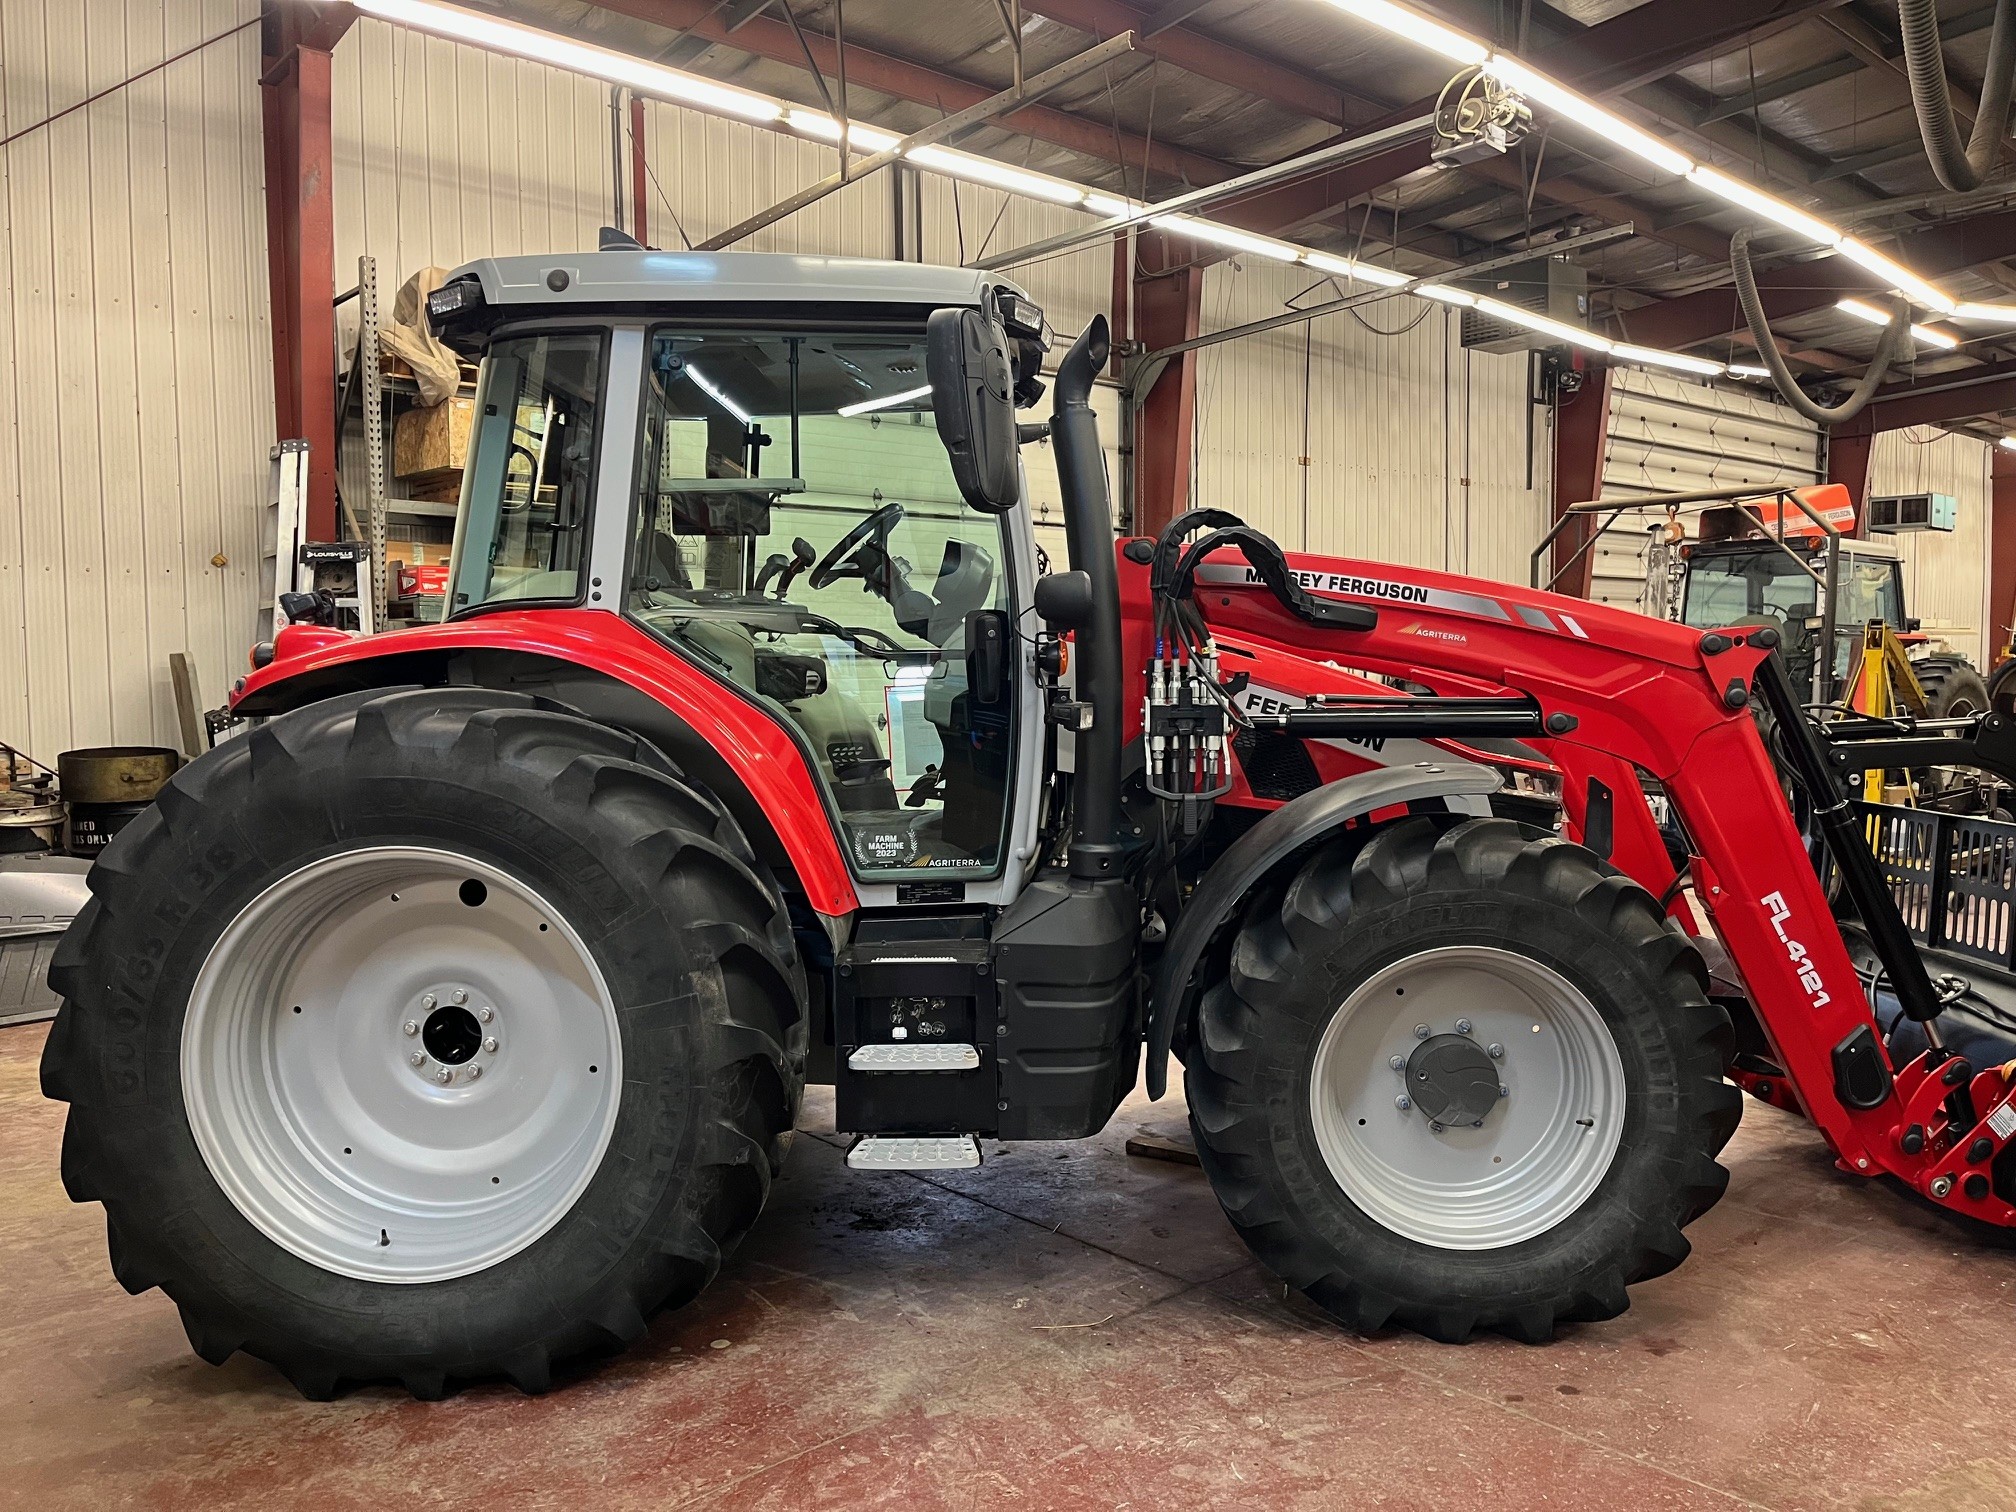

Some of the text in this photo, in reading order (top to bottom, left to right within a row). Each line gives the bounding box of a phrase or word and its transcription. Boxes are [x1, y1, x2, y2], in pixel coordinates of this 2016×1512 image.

[1328, 576, 1428, 603] FERGUSON
[1415, 629, 1467, 643] AGRITERRA
[87, 833, 113, 845] ONLY
[875, 835, 897, 843] FARM
[868, 842, 904, 850] MACHINE
[875, 849, 897, 857] 2023
[928, 859, 981, 867] AGRITERRA
[1760, 890, 1831, 1009] FL.4121
